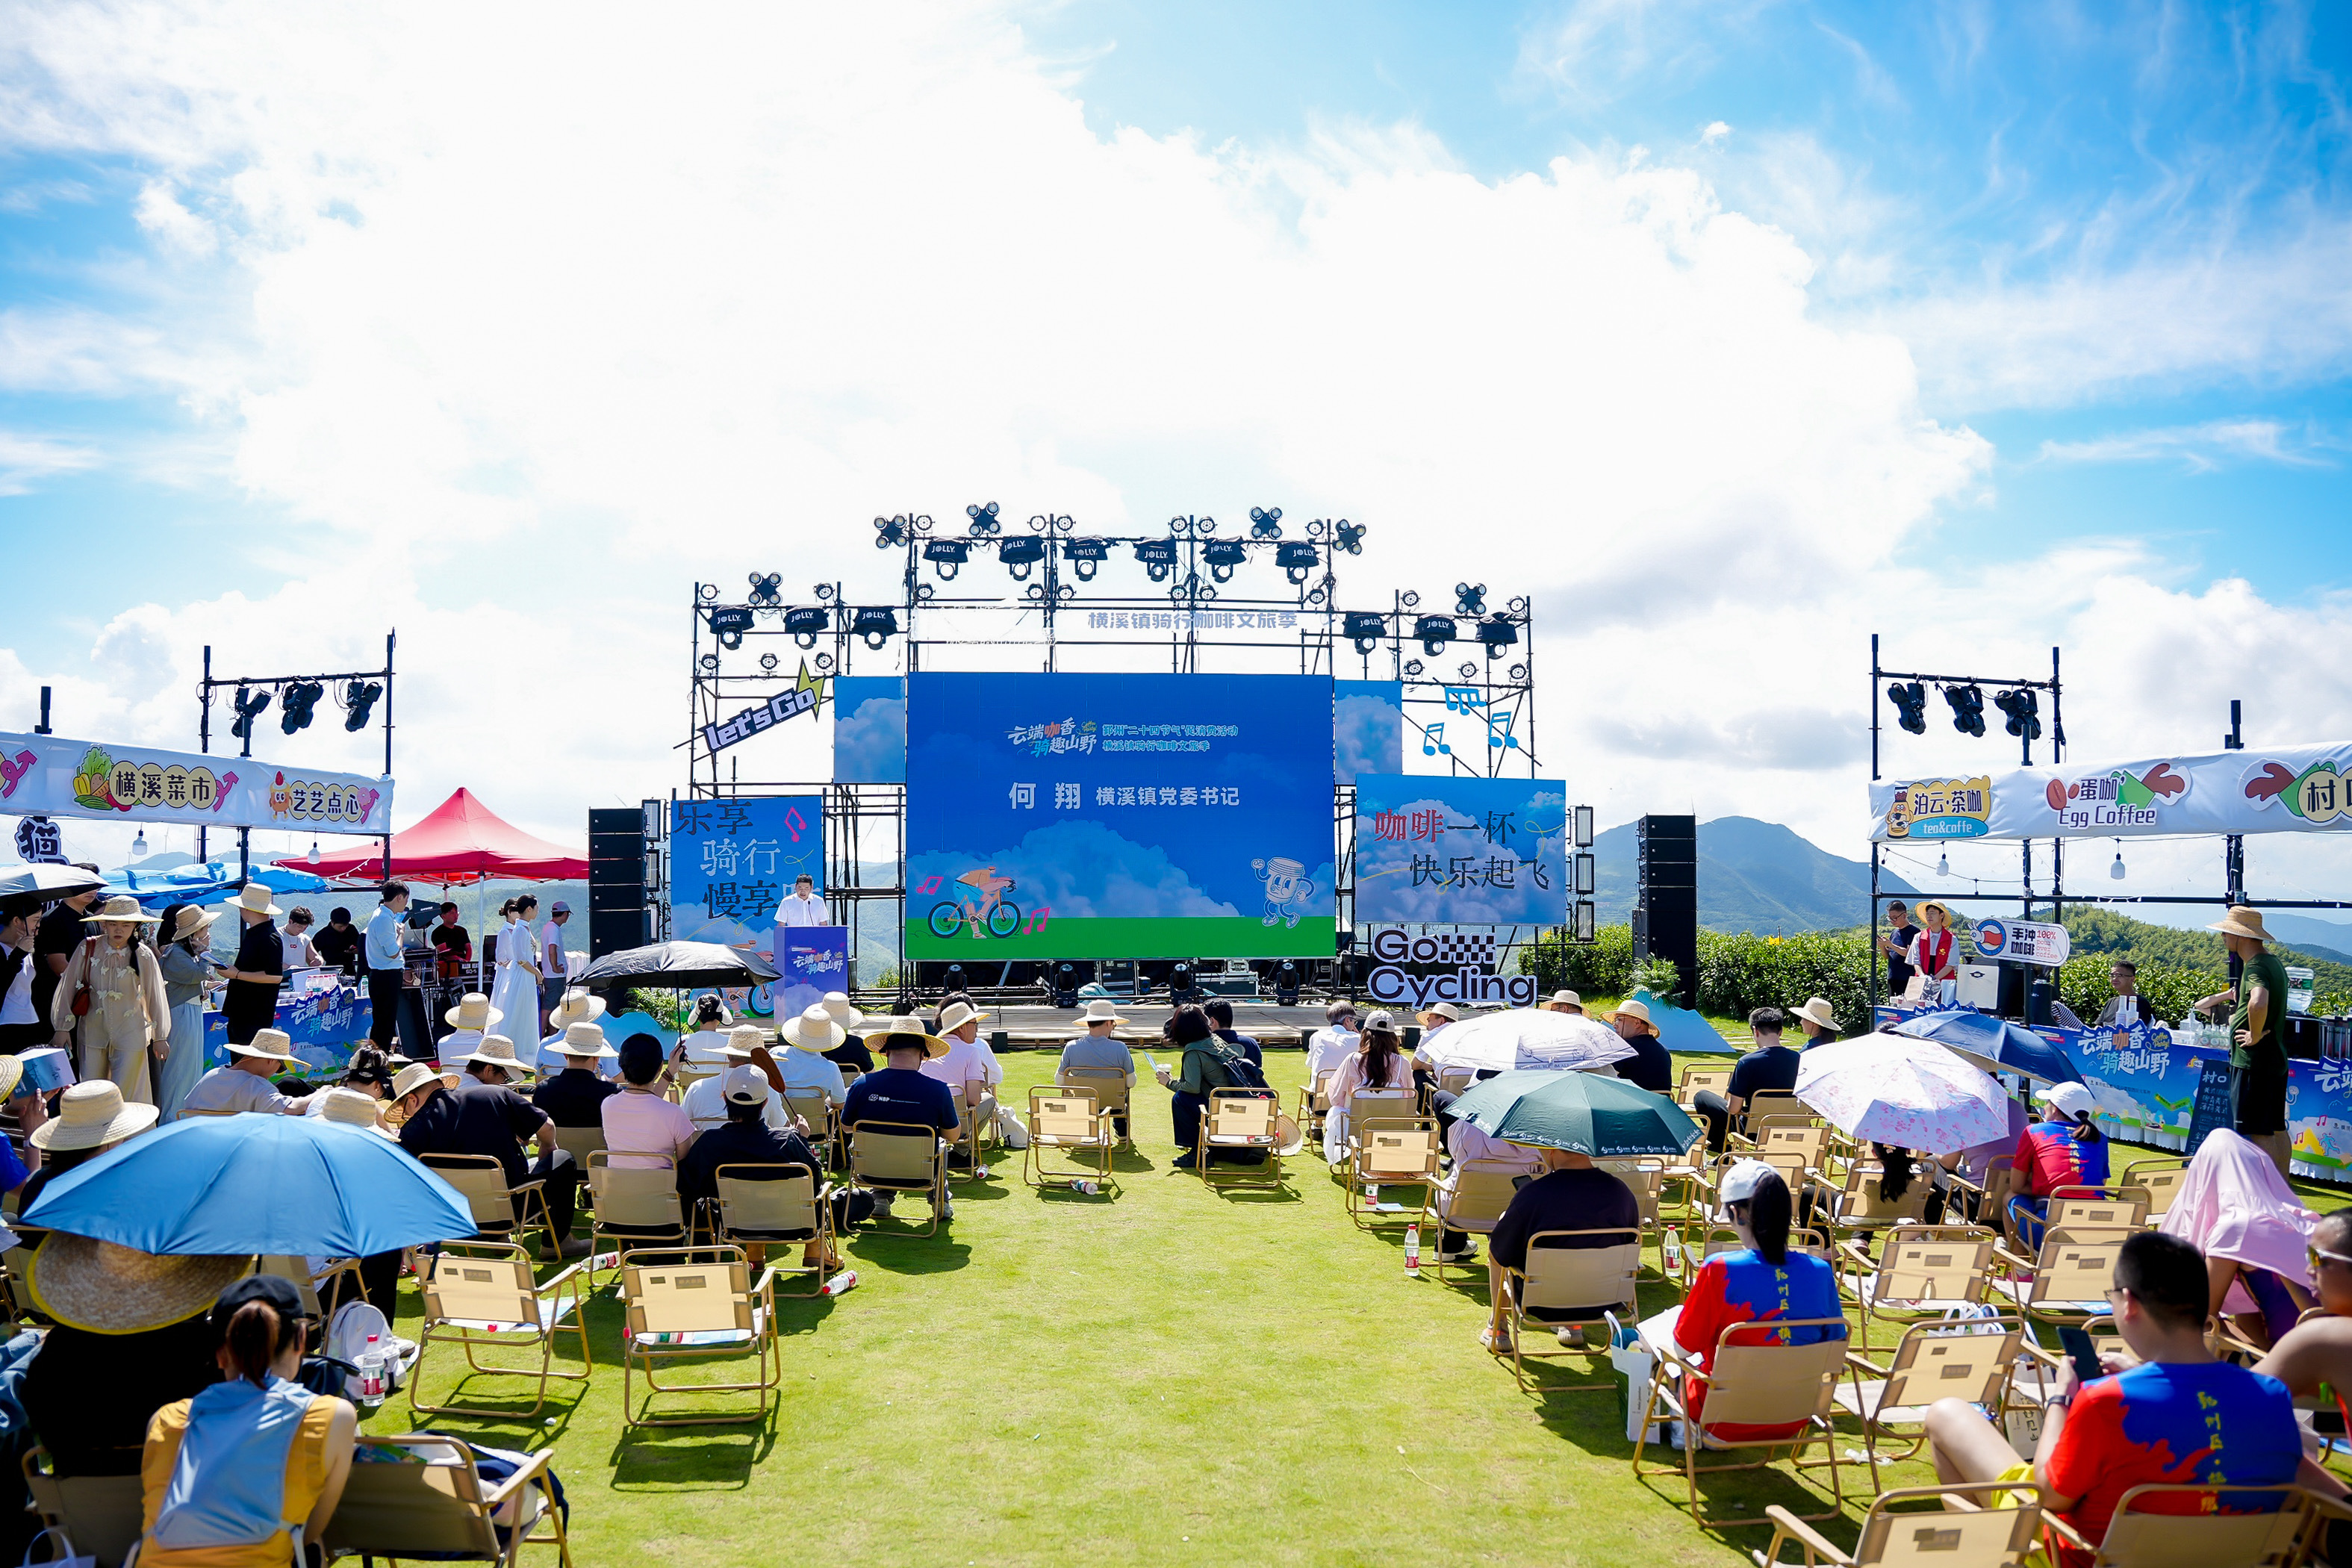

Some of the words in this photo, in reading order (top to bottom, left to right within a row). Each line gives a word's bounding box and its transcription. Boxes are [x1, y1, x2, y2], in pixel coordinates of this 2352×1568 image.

[932, 545, 955, 553] JOLLY
[1144, 550, 1169, 559] JOLLY
[1292, 549, 1315, 557] JOLLY
[717, 614, 741, 623] JOLLY
[791, 612, 814, 623] JOLLY
[862, 612, 886, 620] JOLLY
[1088, 612, 1298, 629] 横溪镇骑行咖啡文旅季
[1360, 619, 1381, 627] JOLLY
[1427, 620, 1450, 629] JOLLY
[1007, 717, 1077, 745] 云端咖香
[1030, 734, 1097, 758] 骑趣山野
[1102, 740, 1210, 752] 横溪镇骑行咖啡文旅季
[116, 771, 211, 801] 横溪菜市
[1096, 786, 1239, 807] 横溪镇党委书记
[293, 788, 359, 815] 艺艺点心
[672, 799, 753, 836] 乐享
[1375, 808, 1516, 844] 咖啡一杯
[2059, 806, 2089, 828] Egg
[2095, 804, 2156, 824] Coffee
[700, 838, 781, 877] 骑行
[1409, 853, 1550, 890] 快乐起飞
[2011, 927, 2036, 942] 手冲
[2037, 930, 2056, 940] 100%
[1375, 930, 1439, 963] Go
[2010, 941, 2035, 956] 咖啡
[1370, 967, 1534, 1007] Cycling
[291, 990, 340, 1025] 云端咖香
[307, 1007, 354, 1038] 骑趣山野
[2077, 1024, 2147, 1056] 云端咖香
[2100, 1049, 2171, 1081] 骑趣山野
[2202, 1070, 2228, 1084] 村口
